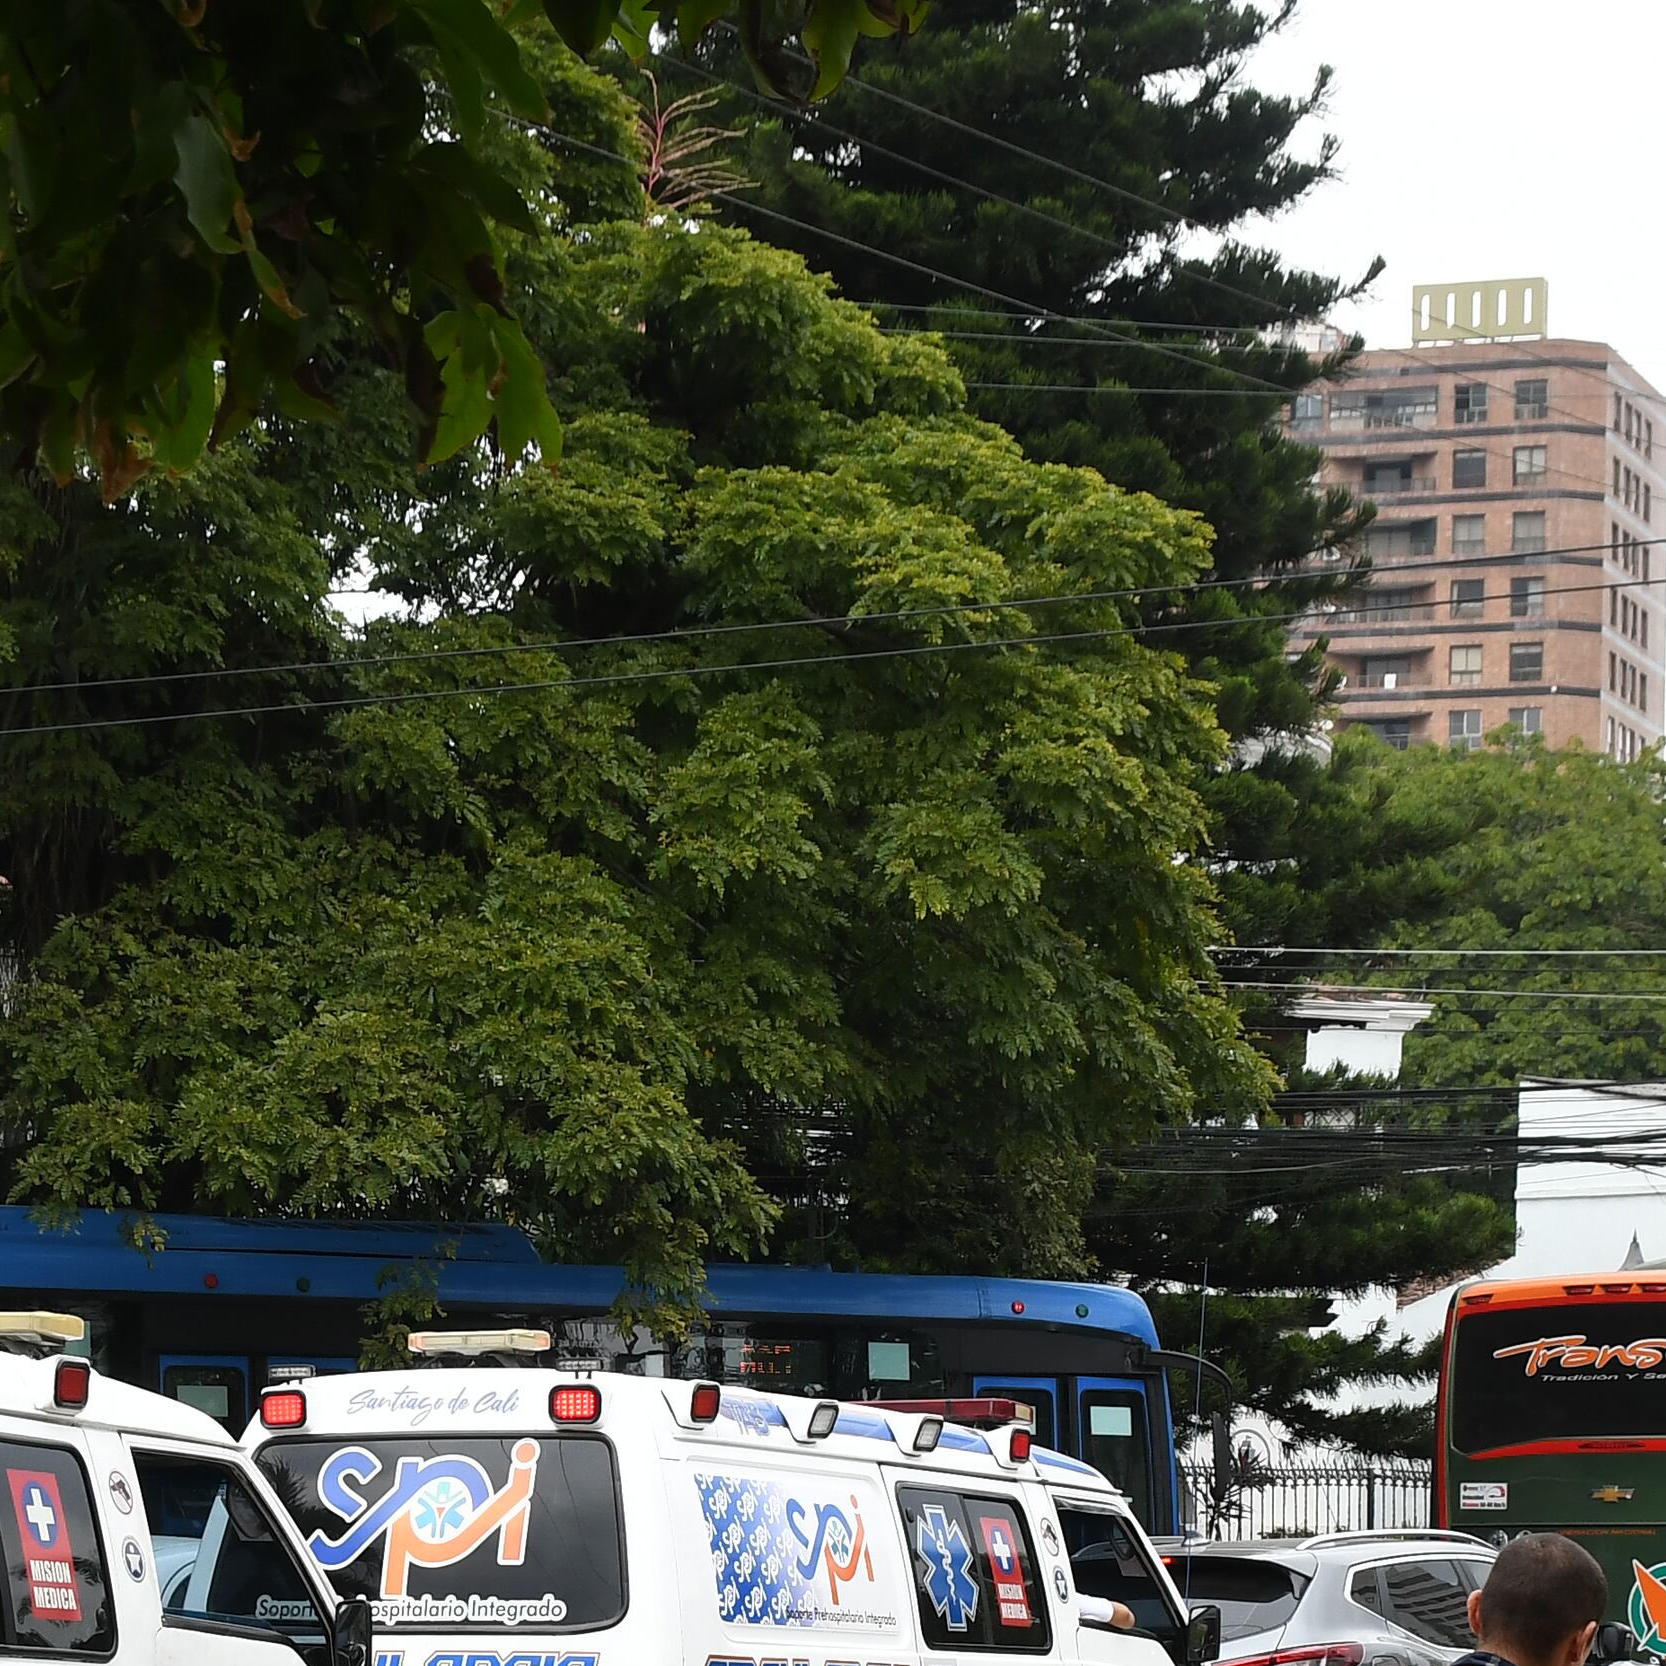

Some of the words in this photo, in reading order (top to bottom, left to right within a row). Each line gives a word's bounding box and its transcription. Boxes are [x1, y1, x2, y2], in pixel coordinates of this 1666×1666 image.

[347, 1386, 444, 1427] Santiago
[448, 1387, 471, 1414] de
[473, 1388, 520, 1414] Cali
[30, 1559, 72, 1585] MISION
[33, 1586, 78, 1611] MEDICA
[471, 1597, 563, 1621] Integrado
